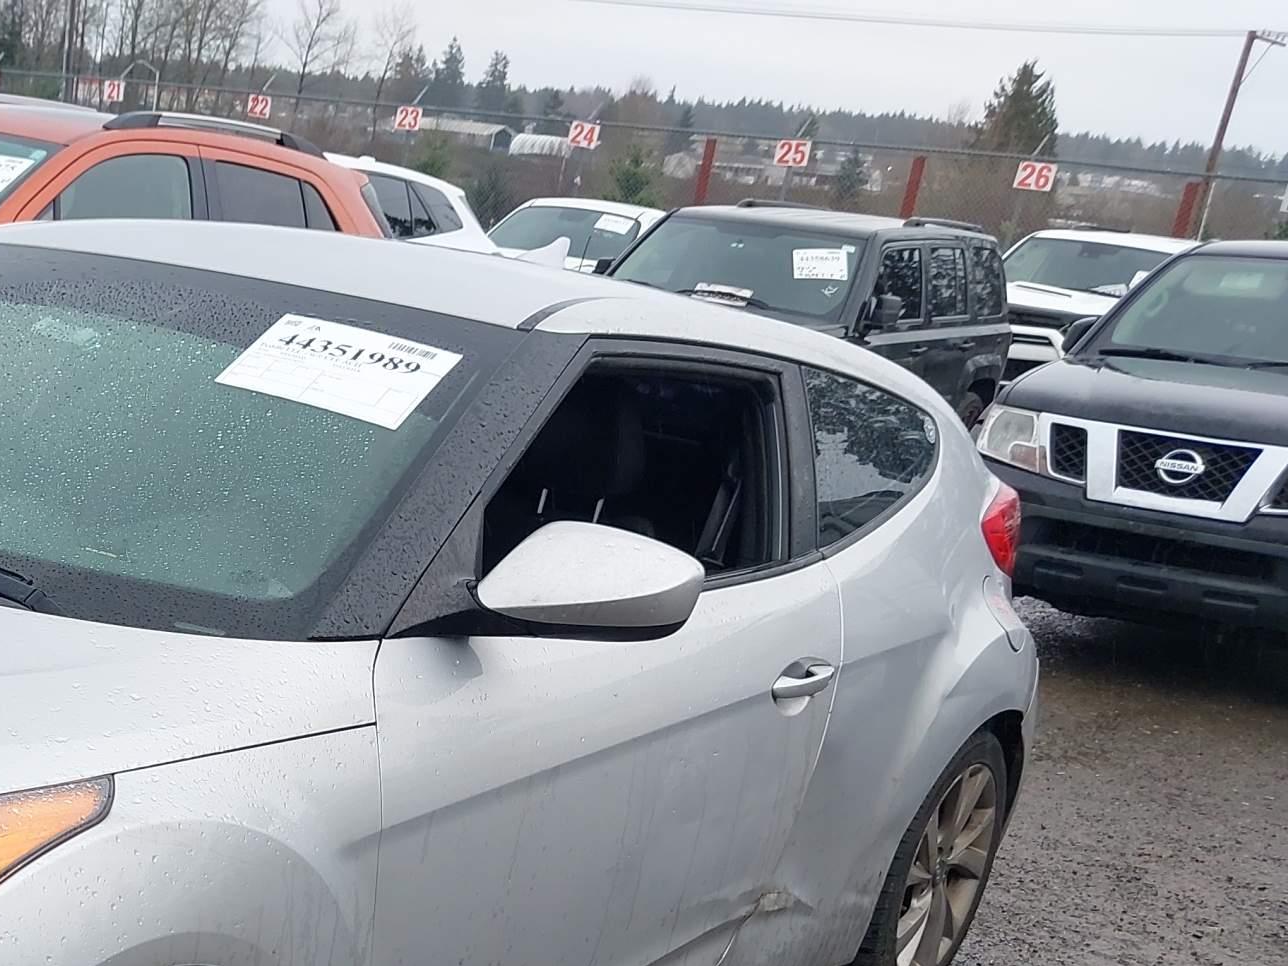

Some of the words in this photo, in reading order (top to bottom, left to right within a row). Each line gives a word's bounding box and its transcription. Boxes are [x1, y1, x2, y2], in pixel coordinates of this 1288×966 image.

[107, 82, 121, 100] 21
[248, 96, 269, 117] 22
[397, 108, 419, 129] 23
[570, 123, 597, 146] 24
[777, 142, 806, 165] 25
[1017, 164, 1050, 189] 26
[278, 333, 421, 374] 44351989
[1159, 460, 1199, 472] NISSAN
